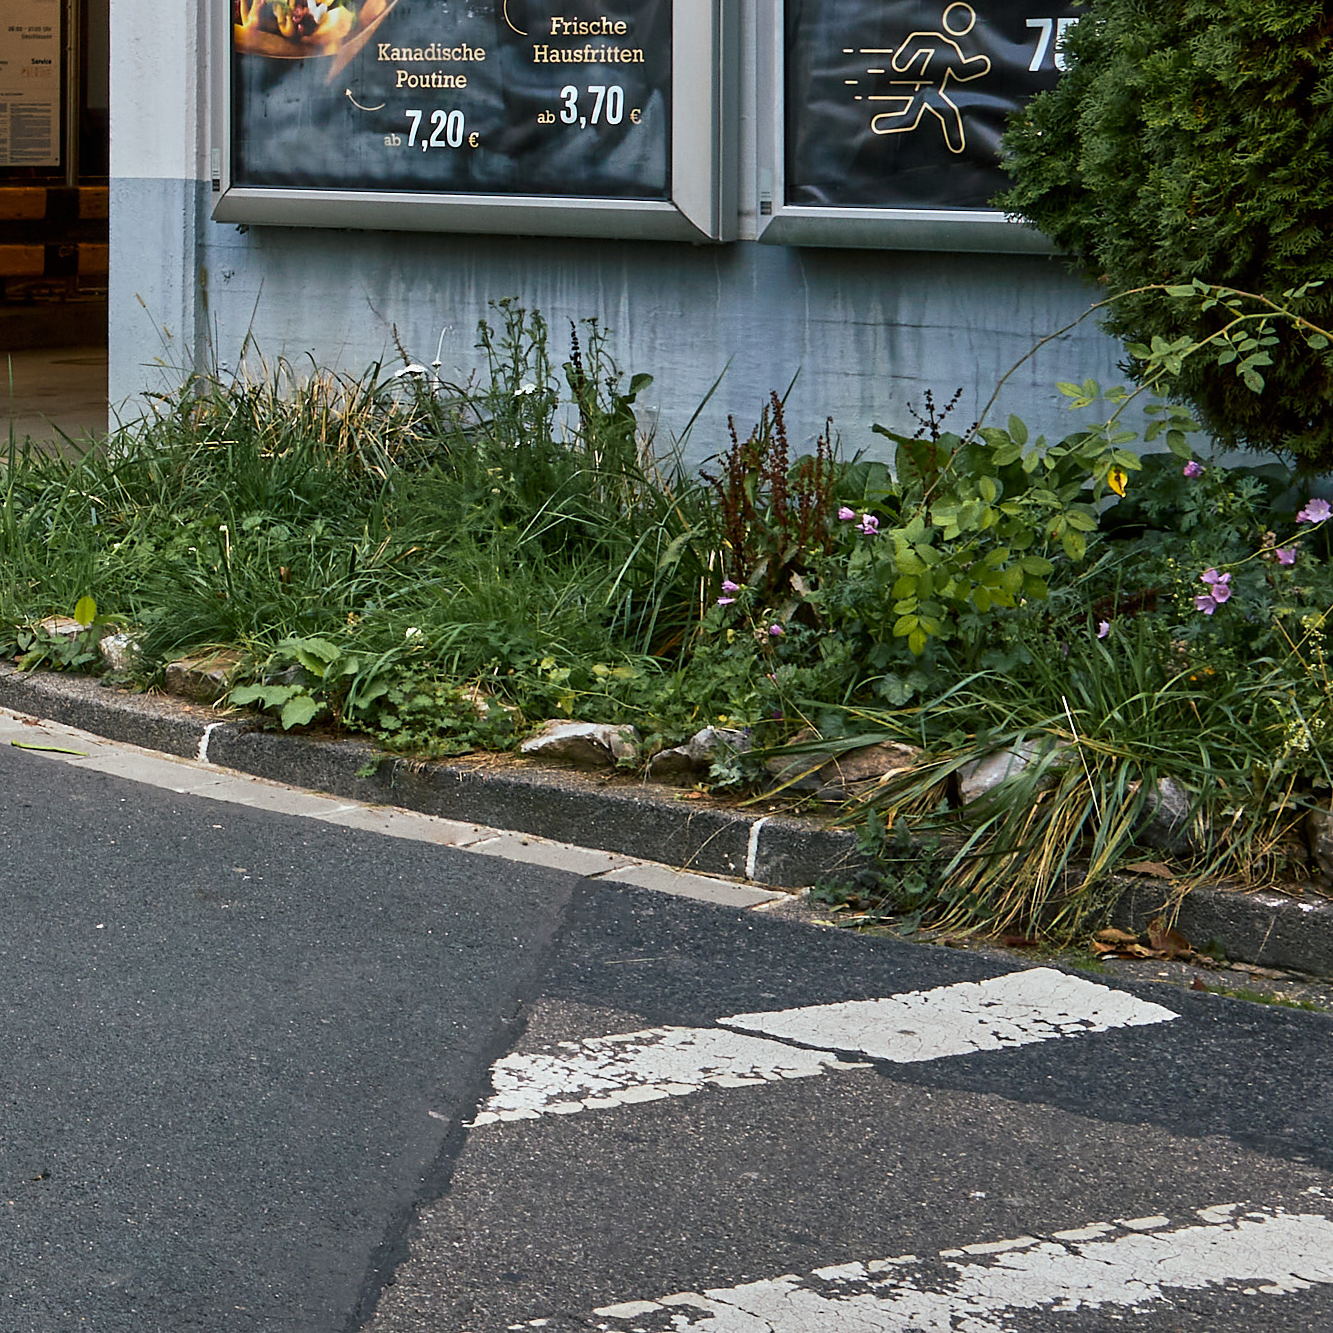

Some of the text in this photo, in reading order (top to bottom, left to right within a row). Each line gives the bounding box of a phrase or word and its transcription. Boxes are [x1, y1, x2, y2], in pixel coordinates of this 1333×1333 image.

[550, 16, 628, 36] Frische
[377, 43, 486, 62] Kanadische
[533, 44, 645, 64] Hausfritten
[395, 70, 467, 89] Poutine
[536, 85, 643, 130] ab 3,70 €
[383, 109, 479, 152] ab 7,20 €
